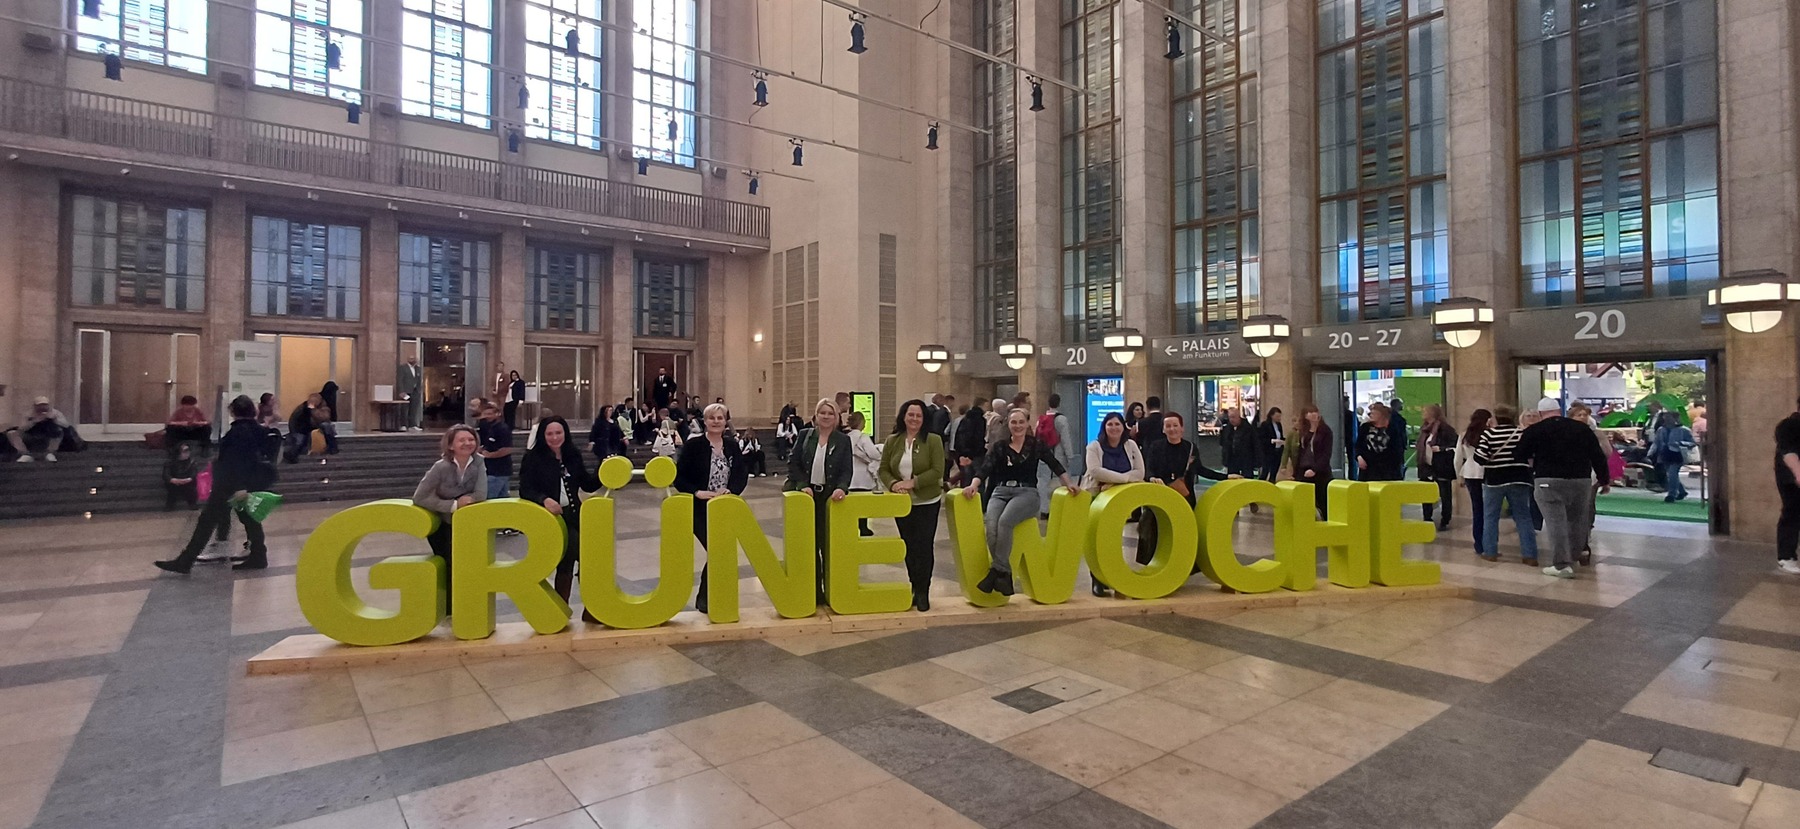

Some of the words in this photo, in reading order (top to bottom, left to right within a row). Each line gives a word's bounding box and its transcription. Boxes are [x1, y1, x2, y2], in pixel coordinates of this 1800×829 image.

[1574, 309, 1626, 340] 20
[1182, 337, 1230, 352] PALAIS
[1328, 331, 1353, 349] 20
[1376, 328, 1402, 346] 27
[1066, 346, 1087, 366] 20
[1194, 350, 1230, 359] Funkturm
[296, 455, 913, 647] GRÜNE
[945, 479, 1442, 608] WOCHE
